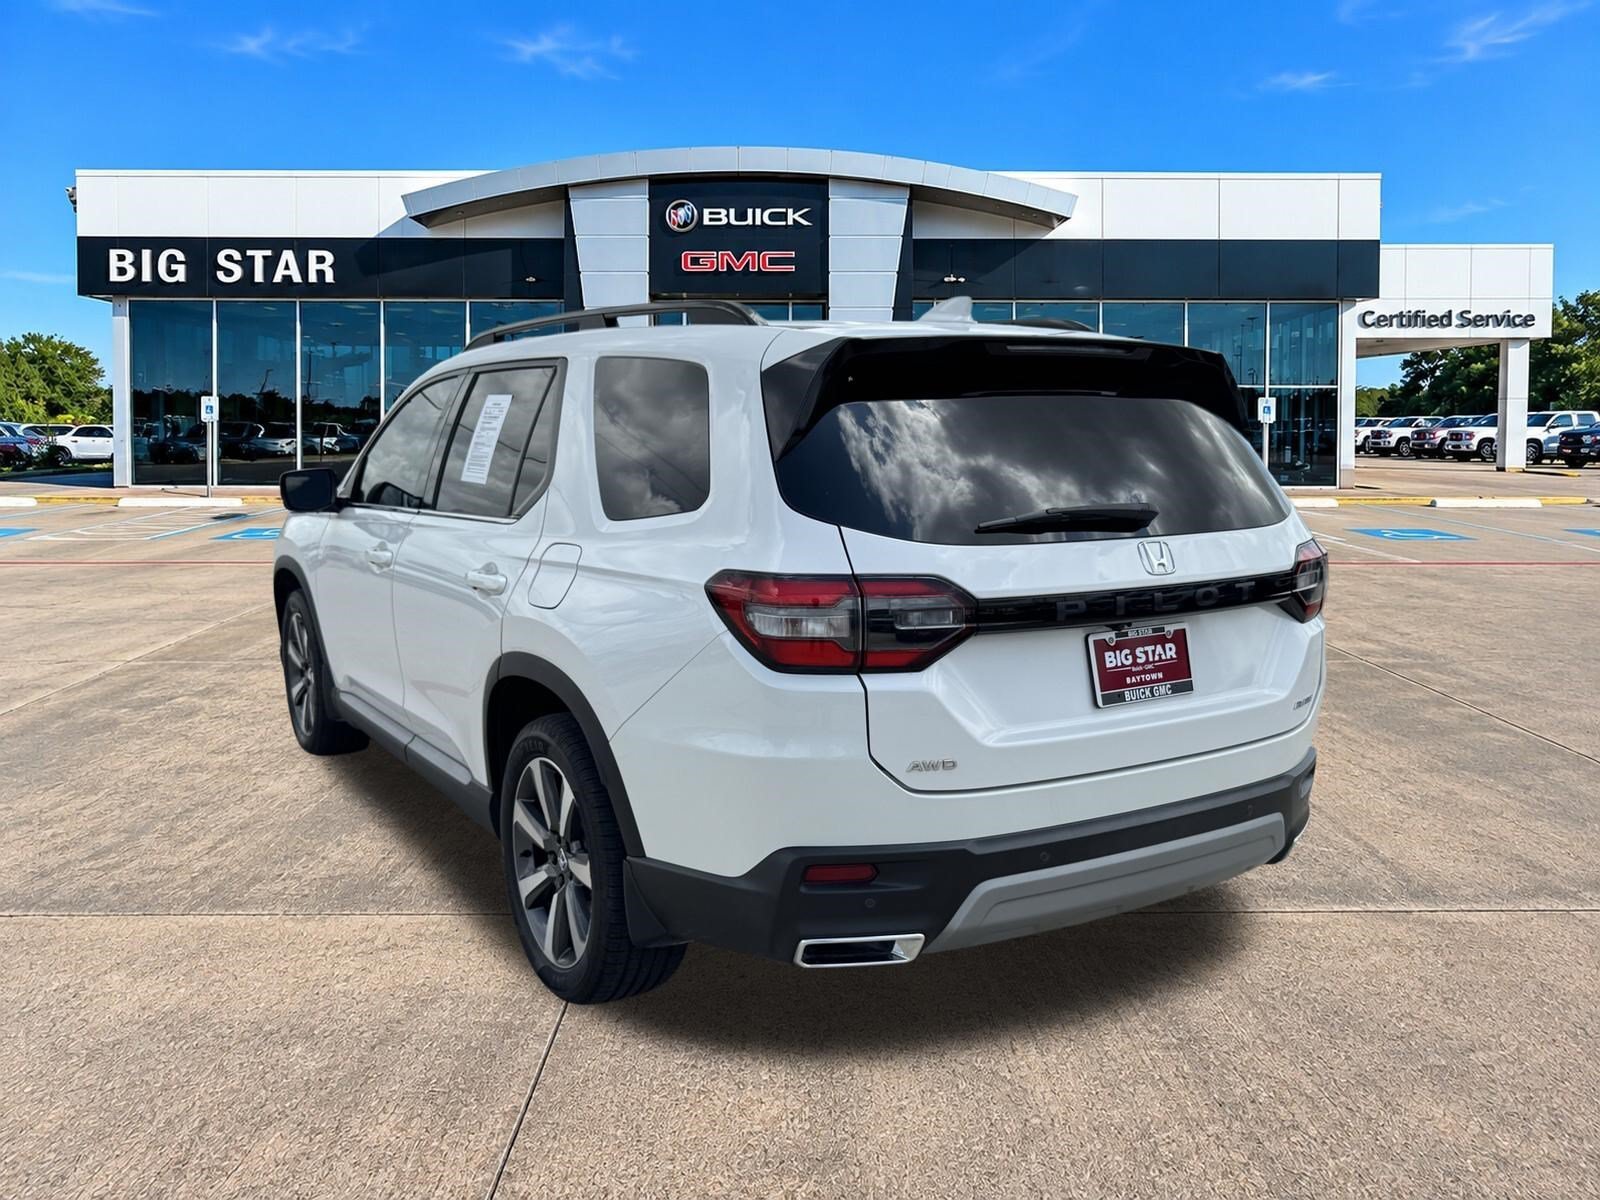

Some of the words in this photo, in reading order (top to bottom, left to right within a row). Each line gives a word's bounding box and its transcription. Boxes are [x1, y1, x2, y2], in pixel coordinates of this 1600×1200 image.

[702, 207, 813, 226] BUICK
[108, 248, 187, 283] BIG
[215, 248, 335, 283] STAR
[680, 250, 796, 272] GMC
[1360, 309, 1453, 328] Certified
[1459, 309, 1536, 328] Service
[1056, 581, 1255, 621] PILOT
[1104, 648, 1133, 668] BIG
[1135, 643, 1177, 663] STAR
[1126, 672, 1163, 684] BAYTOWN
[1124, 687, 1152, 701] BUICK
[1153, 684, 1172, 696] GMC
[905, 759, 958, 772] AWD
